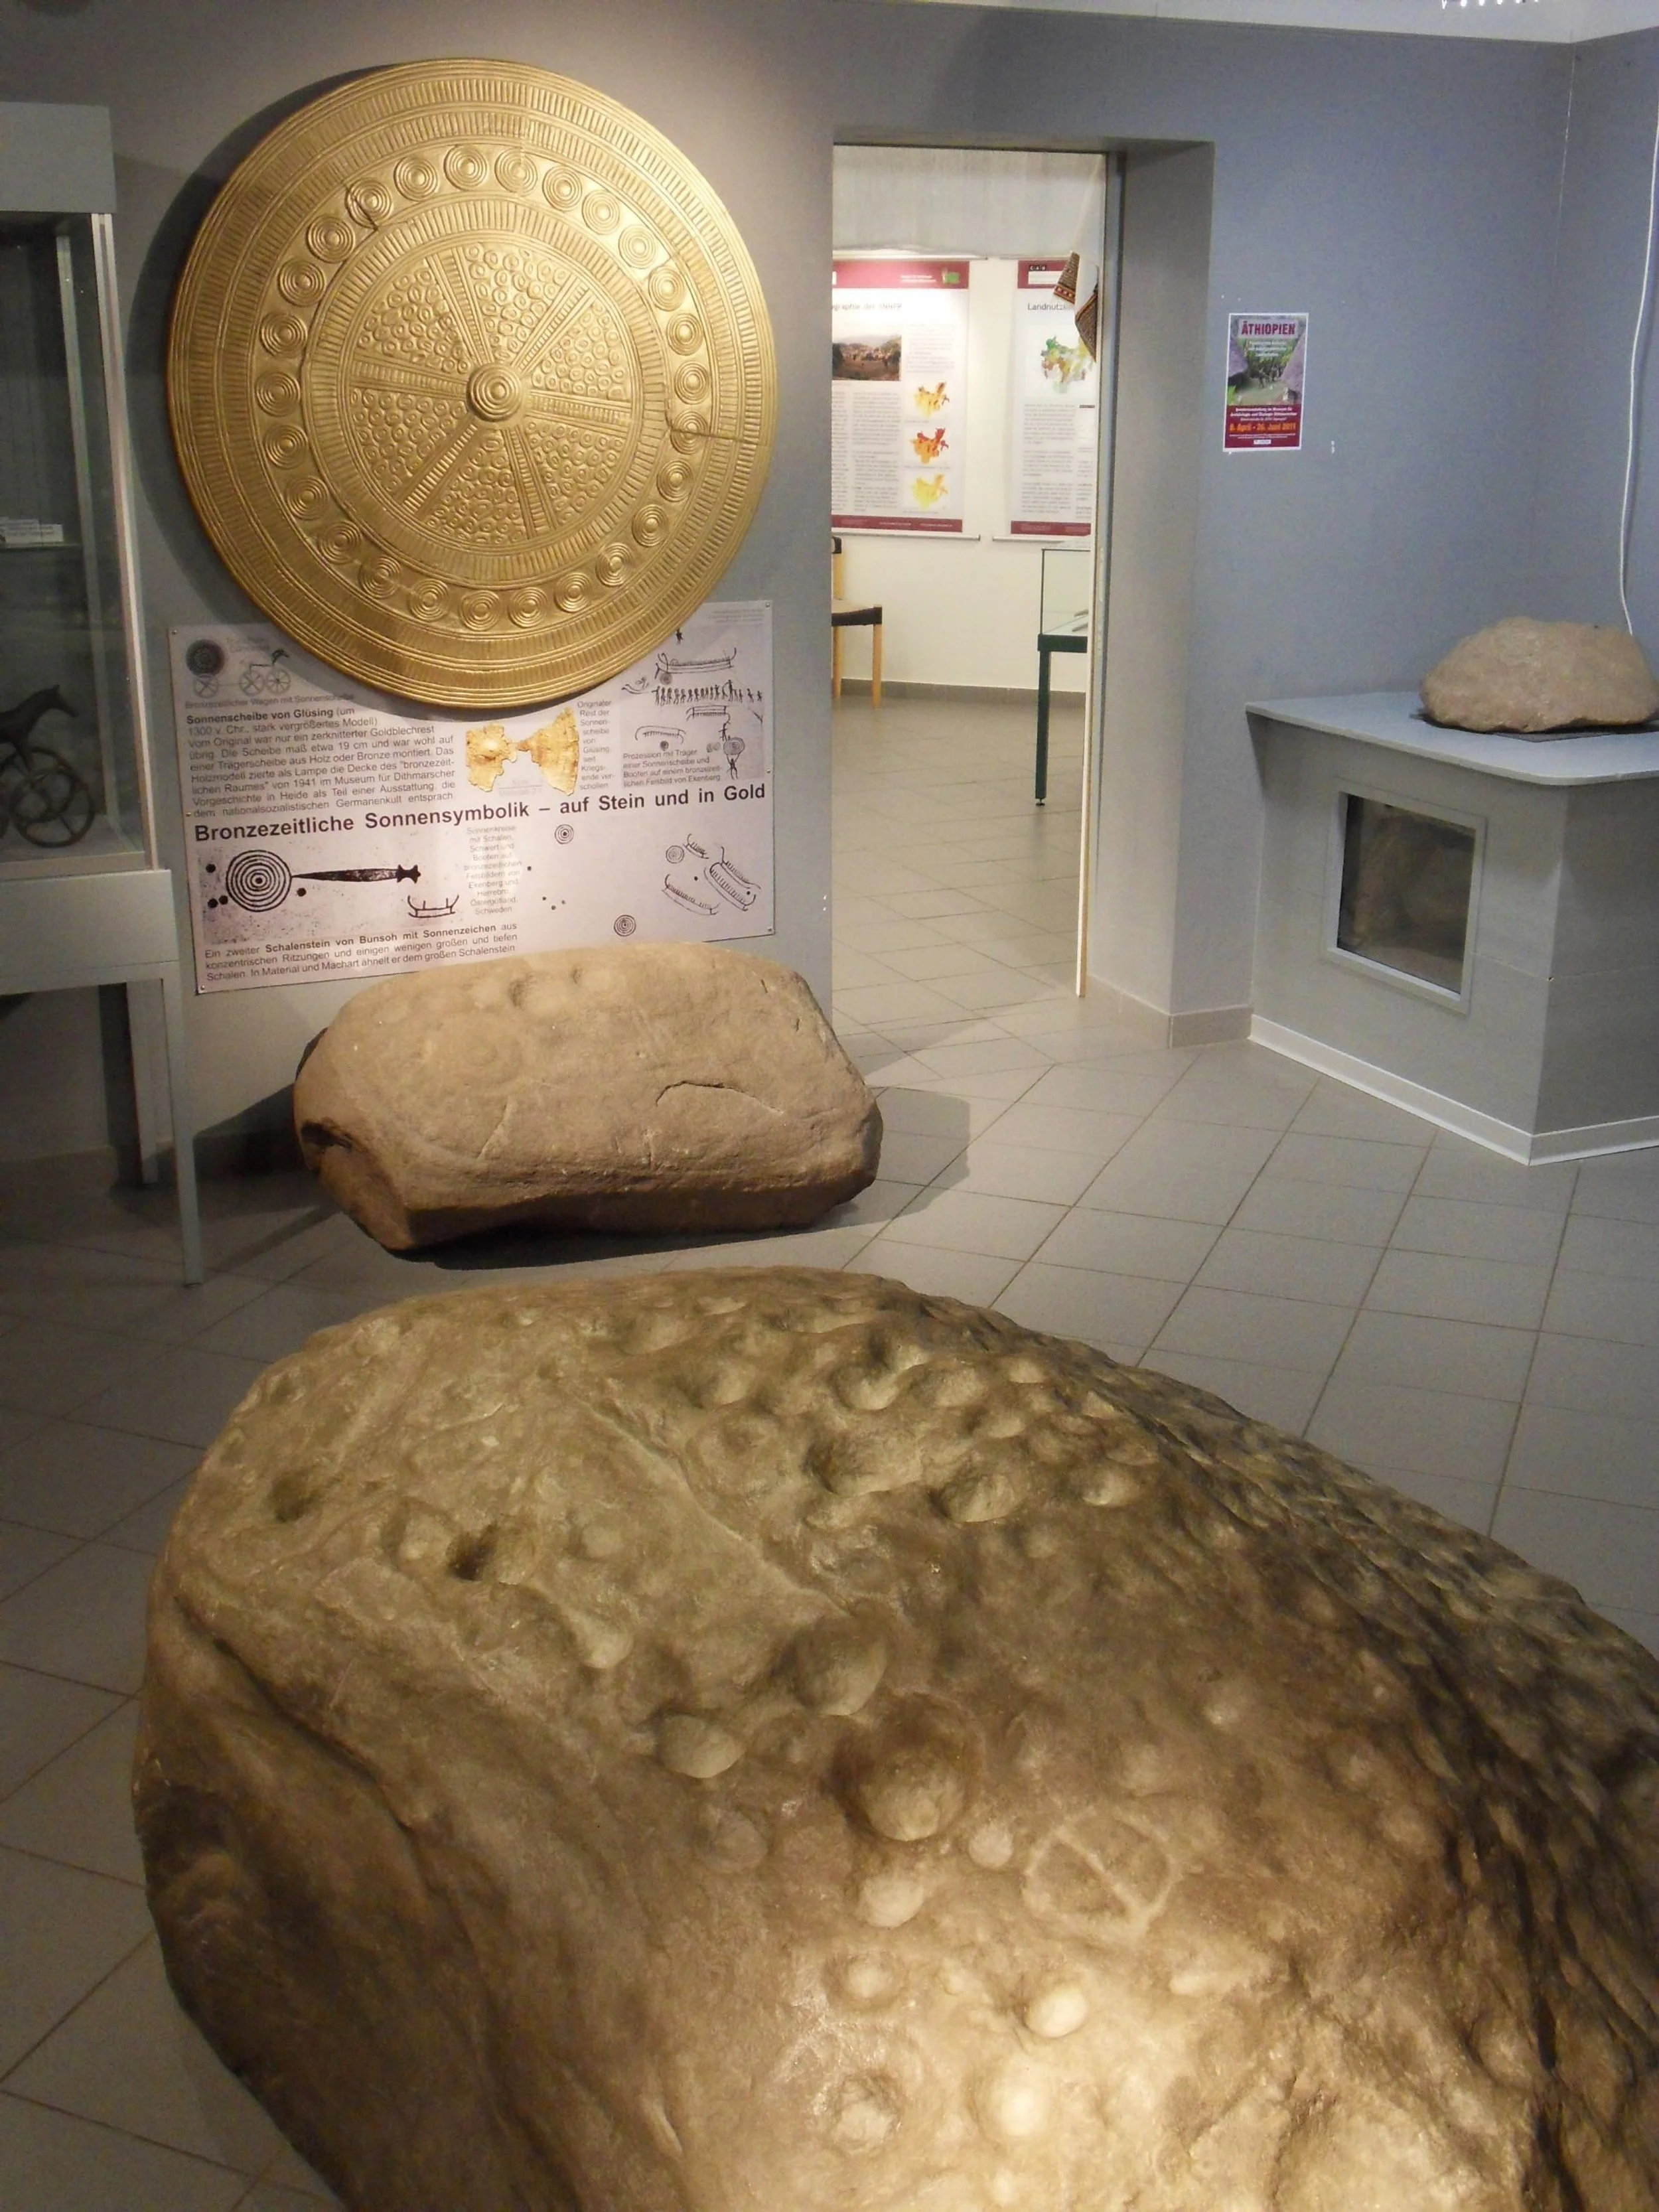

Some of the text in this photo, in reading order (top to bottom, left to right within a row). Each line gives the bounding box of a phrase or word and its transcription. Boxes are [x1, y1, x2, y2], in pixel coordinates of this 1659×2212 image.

[1242, 321, 1295, 335] ÄTHIOPIEN
[577, 699, 612, 709] Originaler
[186, 712, 268, 724] Sonnenscheibe
[293, 708, 334, 717] Glüsing
[336, 707, 354, 716] (um
[188, 727, 212, 736] 1300
[253, 722, 275, 732] stark
[342, 717, 378, 727] Modell)
[214, 736, 252, 747] Original
[275, 734, 291, 743] nur
[294, 732, 308, 741] ein
[311, 730, 368, 741] zerknitterter
[370, 726, 434, 737] Goldblechrest
[222, 749, 238, 758] Die
[242, 746, 281, 757] Scheibe
[285, 744, 307, 753] maß
[311, 743, 333, 752] etwa
[414, 737, 435, 745] wohl
[439, 735, 453, 744] auf
[289, 756, 307, 765] aus
[309, 755, 331, 763] Holz
[333, 753, 354, 762] oder
[358, 751, 390, 761] Bronze
[436, 747, 454, 756] Das
[249, 770, 275, 780] zierte
[279, 769, 292, 777] als
[295, 767, 328, 776] Lampe
[330, 765, 344, 774] die
[348, 763, 377, 773] Decke
[380, 761, 397, 770] des
[642, 759, 695, 767] Sonnenscheibe
[294, 778, 315, 787] 1941
[335, 775, 375, 784] Museum
[394, 769, 455, 780] Dithmarscher
[192, 794, 261, 807] Vorgeschichte
[281, 790, 308, 800] Heide
[332, 787, 347, 796] Teil
[194, 792, 453, 818] dem nationalsozialistischen Germanenkult entsprach
[195, 816, 354, 842] Bronzezeitliche
[365, 802, 530, 830] Sonnensymbolik
[559, 796, 589, 814] auf
[599, 792, 645, 812] Stein
[654, 788, 688, 806] und
[699, 788, 715, 804] in
[723, 783, 764, 802] Gold
[475, 906, 512, 915] Schweden
[204, 949, 220, 958] Ein
[226, 946, 260, 957] zweiter
[265, 938, 330, 952] Schalenstein
[360, 933, 397, 944] Bunsoh
[403, 931, 419, 940] mit
[423, 924, 496, 938] Sonnenzeichen
[206, 932, 518, 969] konzentrischen Ritzungen und einigen wenigen großen und tiefen
[263, 965, 299, 976] Material
[303, 962, 319, 972] und
[321, 959, 359, 970] Machart
[403, 953, 422, 962] dem
[425, 949, 457, 962] großen
[459, 944, 516, 957] Schalenstein
